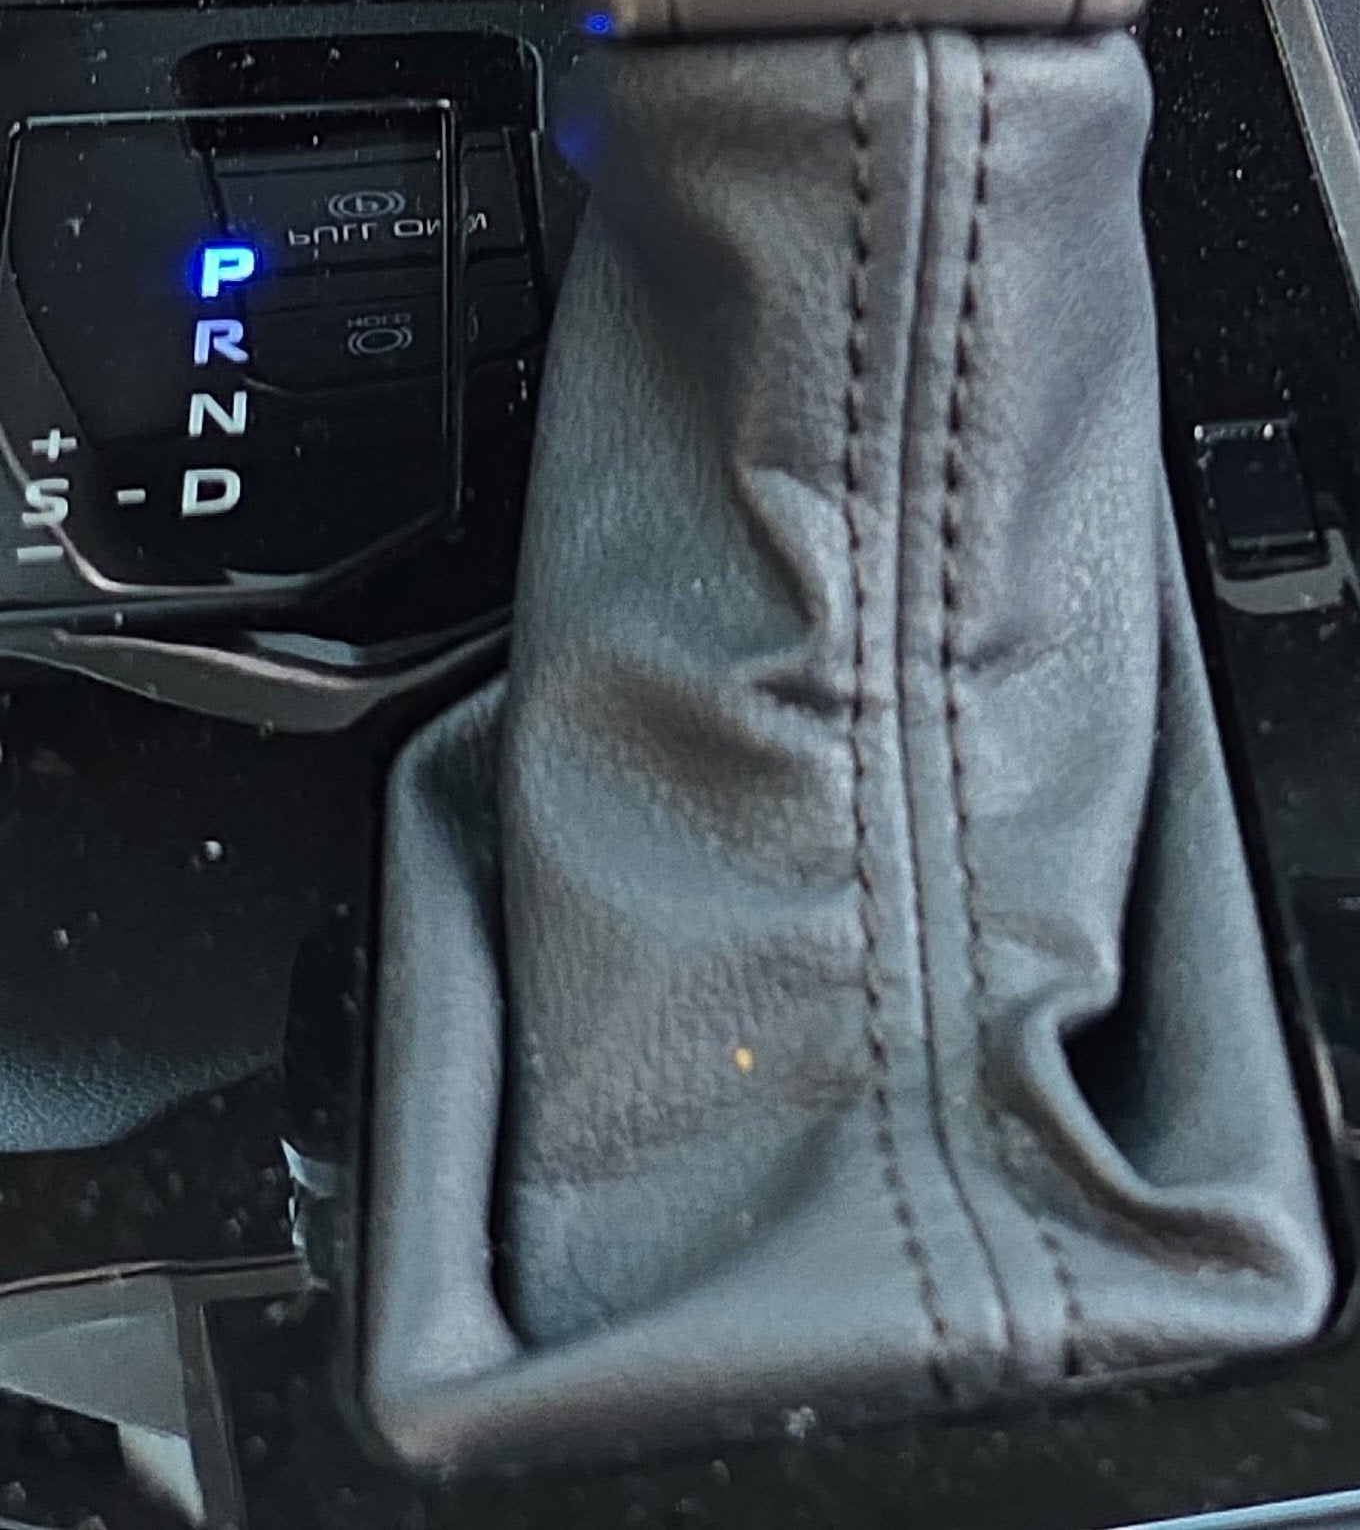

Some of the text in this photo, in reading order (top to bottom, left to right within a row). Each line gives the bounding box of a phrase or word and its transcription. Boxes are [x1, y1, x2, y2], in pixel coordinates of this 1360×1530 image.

[200, 247, 255, 298] P
[194, 319, 249, 365] R
[188, 391, 248, 437] N
[22, 478, 69, 528] S
[182, 468, 241, 517] D
